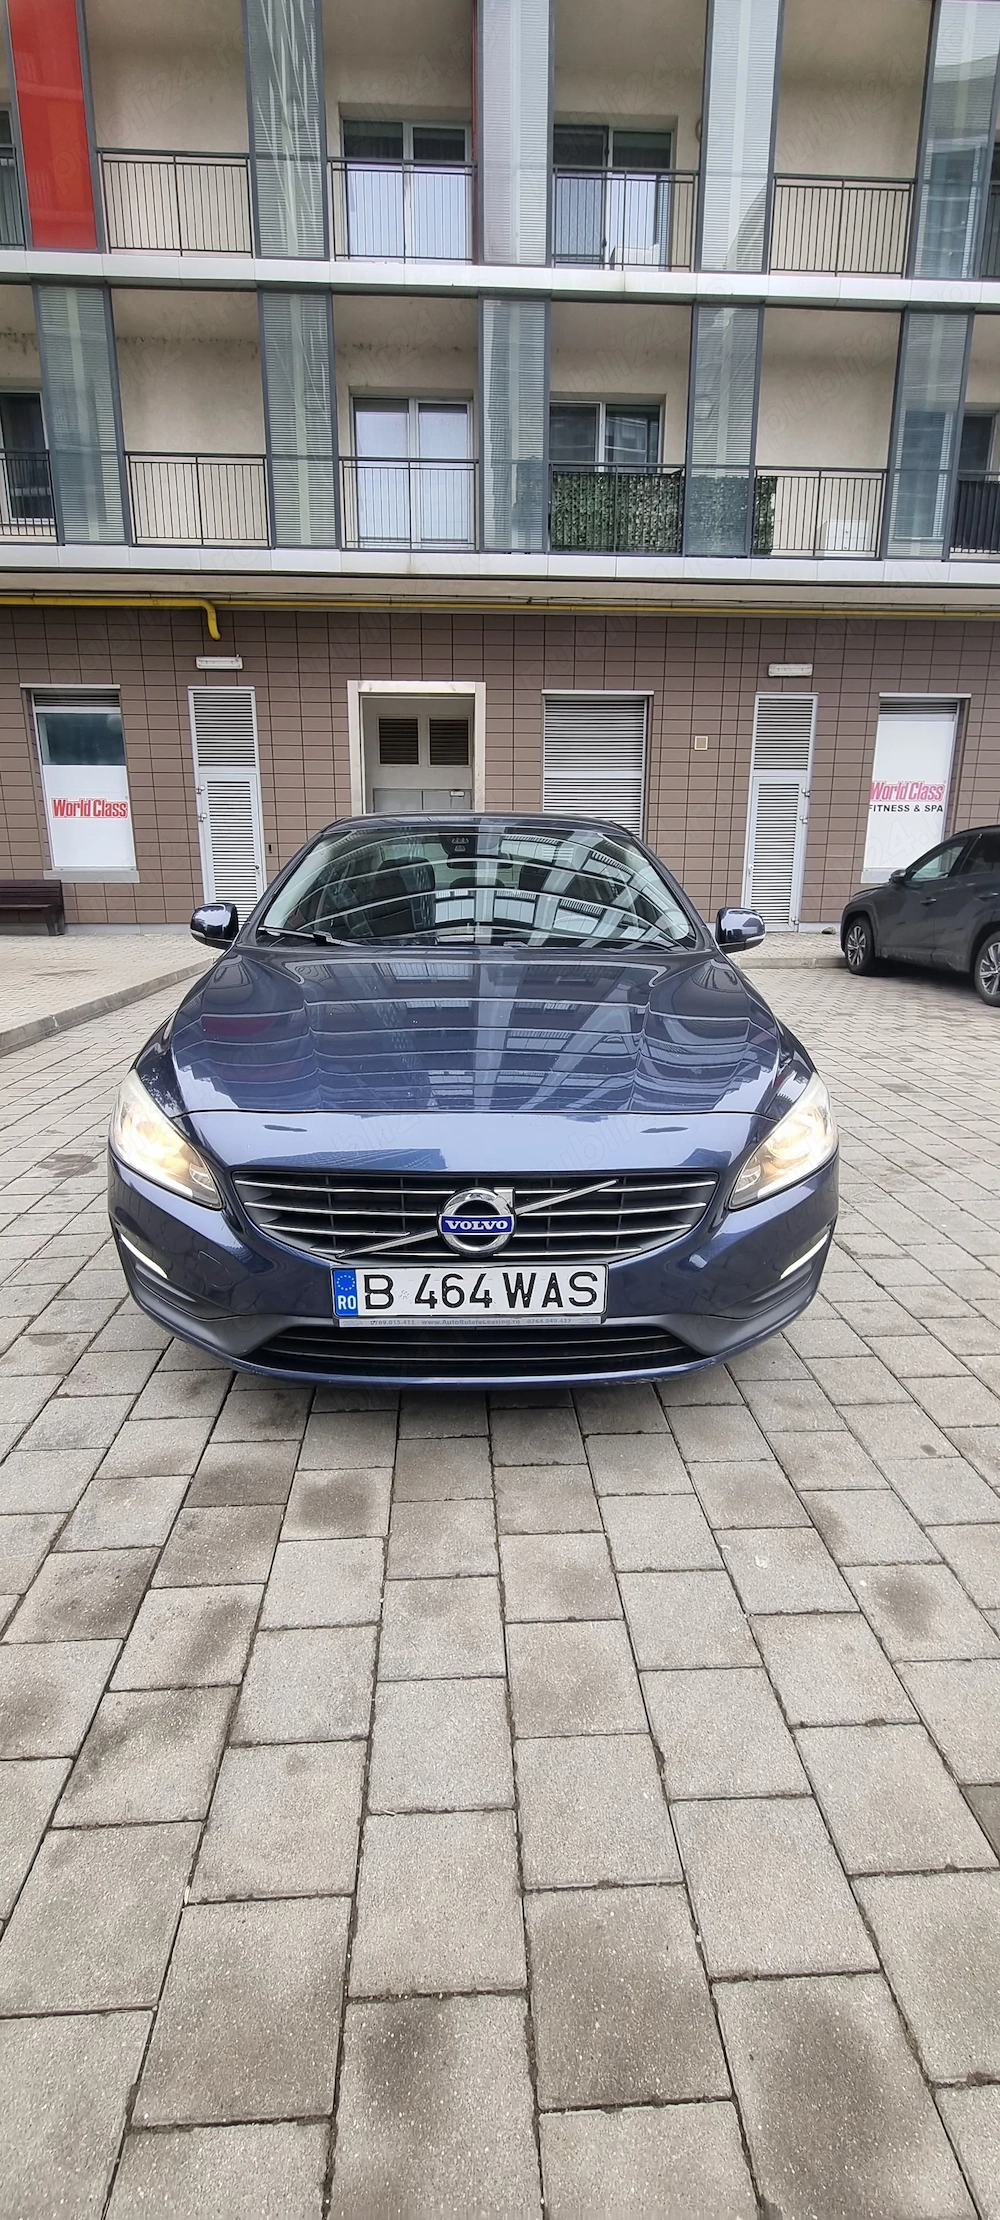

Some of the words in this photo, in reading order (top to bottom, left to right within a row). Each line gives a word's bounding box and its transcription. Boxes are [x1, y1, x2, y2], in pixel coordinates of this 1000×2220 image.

[870, 782, 909, 800] World
[909, 782, 945, 801] Class
[53, 799, 91, 817] World
[93, 799, 127, 817] Class
[445, 1220, 509, 1230] VOLVO
[364, 1274, 394, 1310] B
[414, 1273, 493, 1309] 464
[502, 1271, 598, 1309] WAS
[337, 1295, 357, 1311] RO
